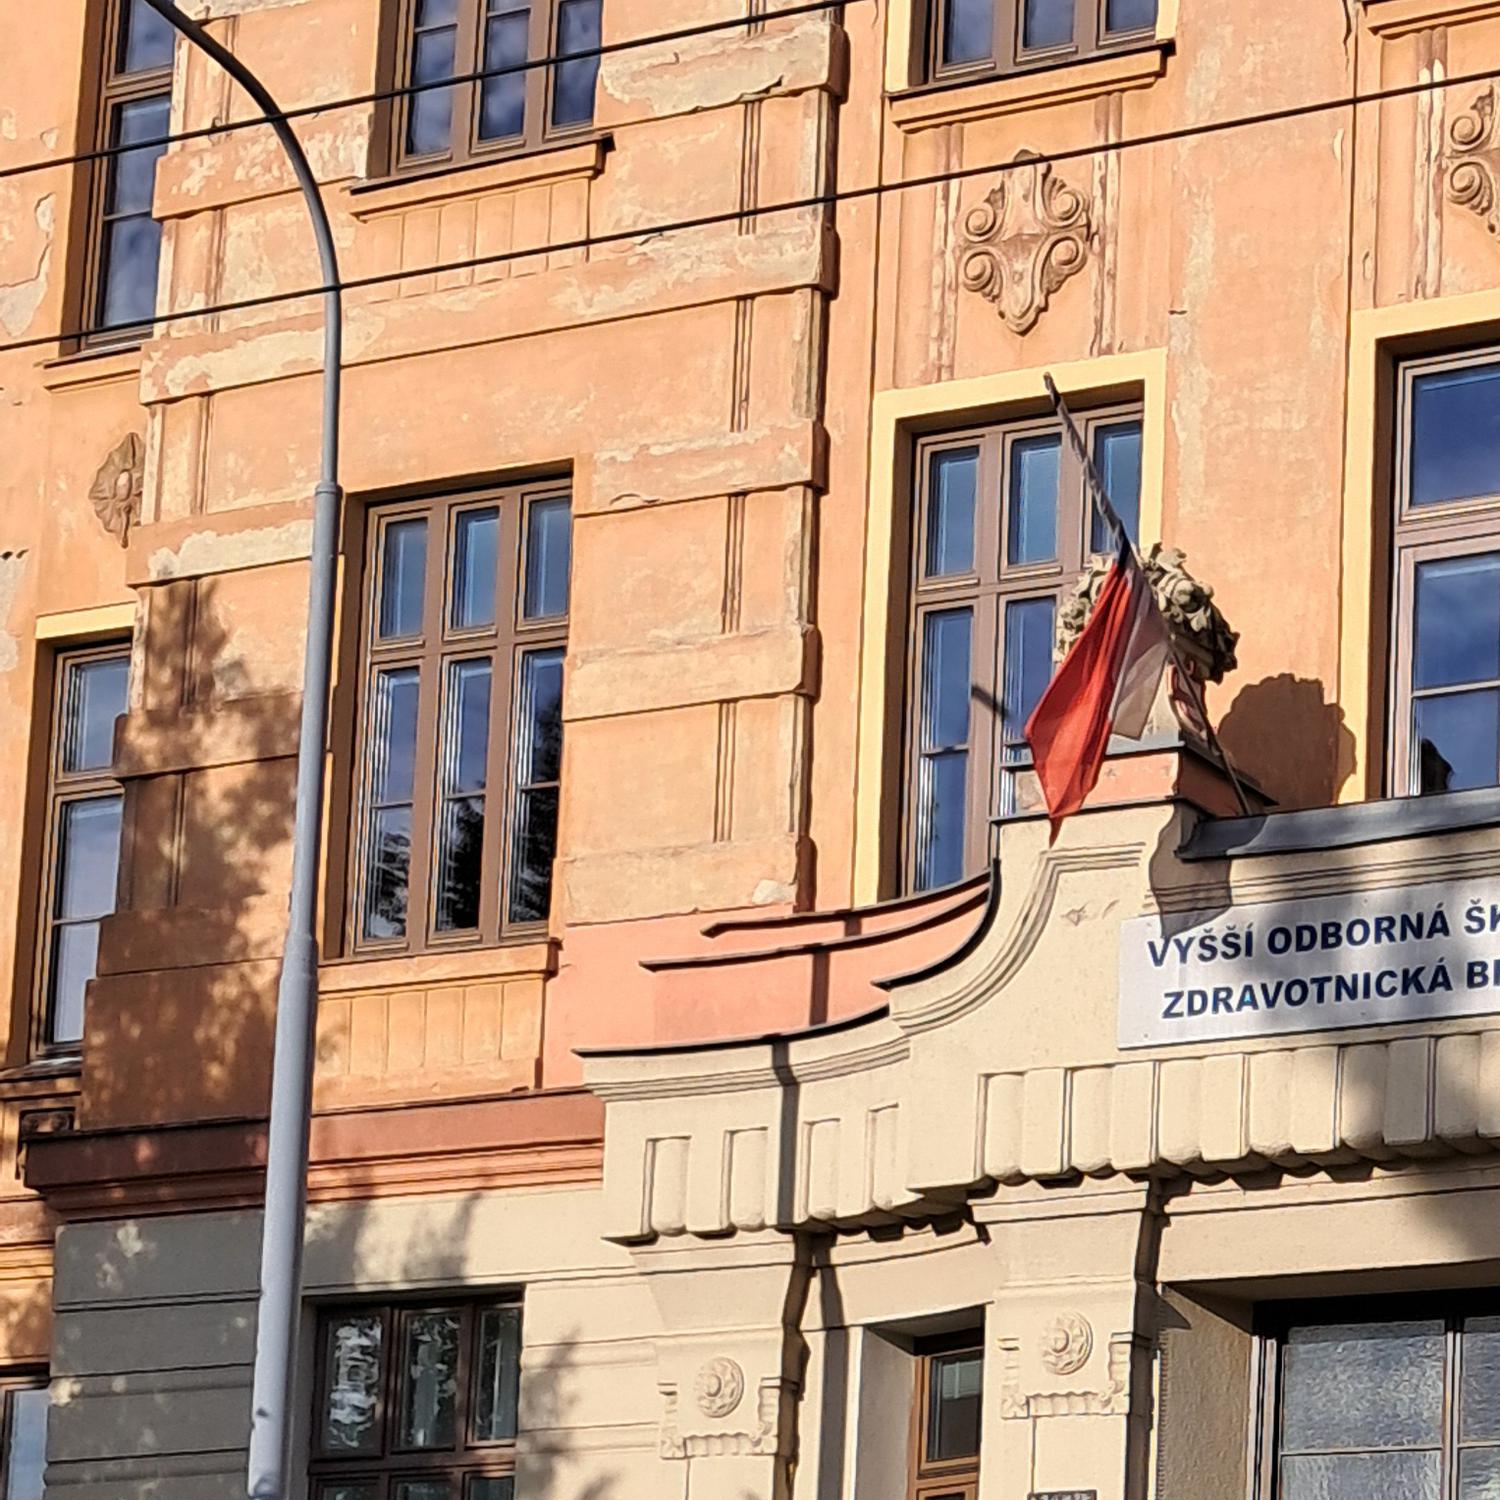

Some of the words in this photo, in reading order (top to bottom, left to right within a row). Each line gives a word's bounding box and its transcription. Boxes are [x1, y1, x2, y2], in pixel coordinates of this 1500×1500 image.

[1148, 924, 1254, 967] VYŠŠÍ
[1267, 902, 1451, 955] ODBORNÁ
[1162, 957, 1453, 1018] ZDRAVOTNICKÁ
